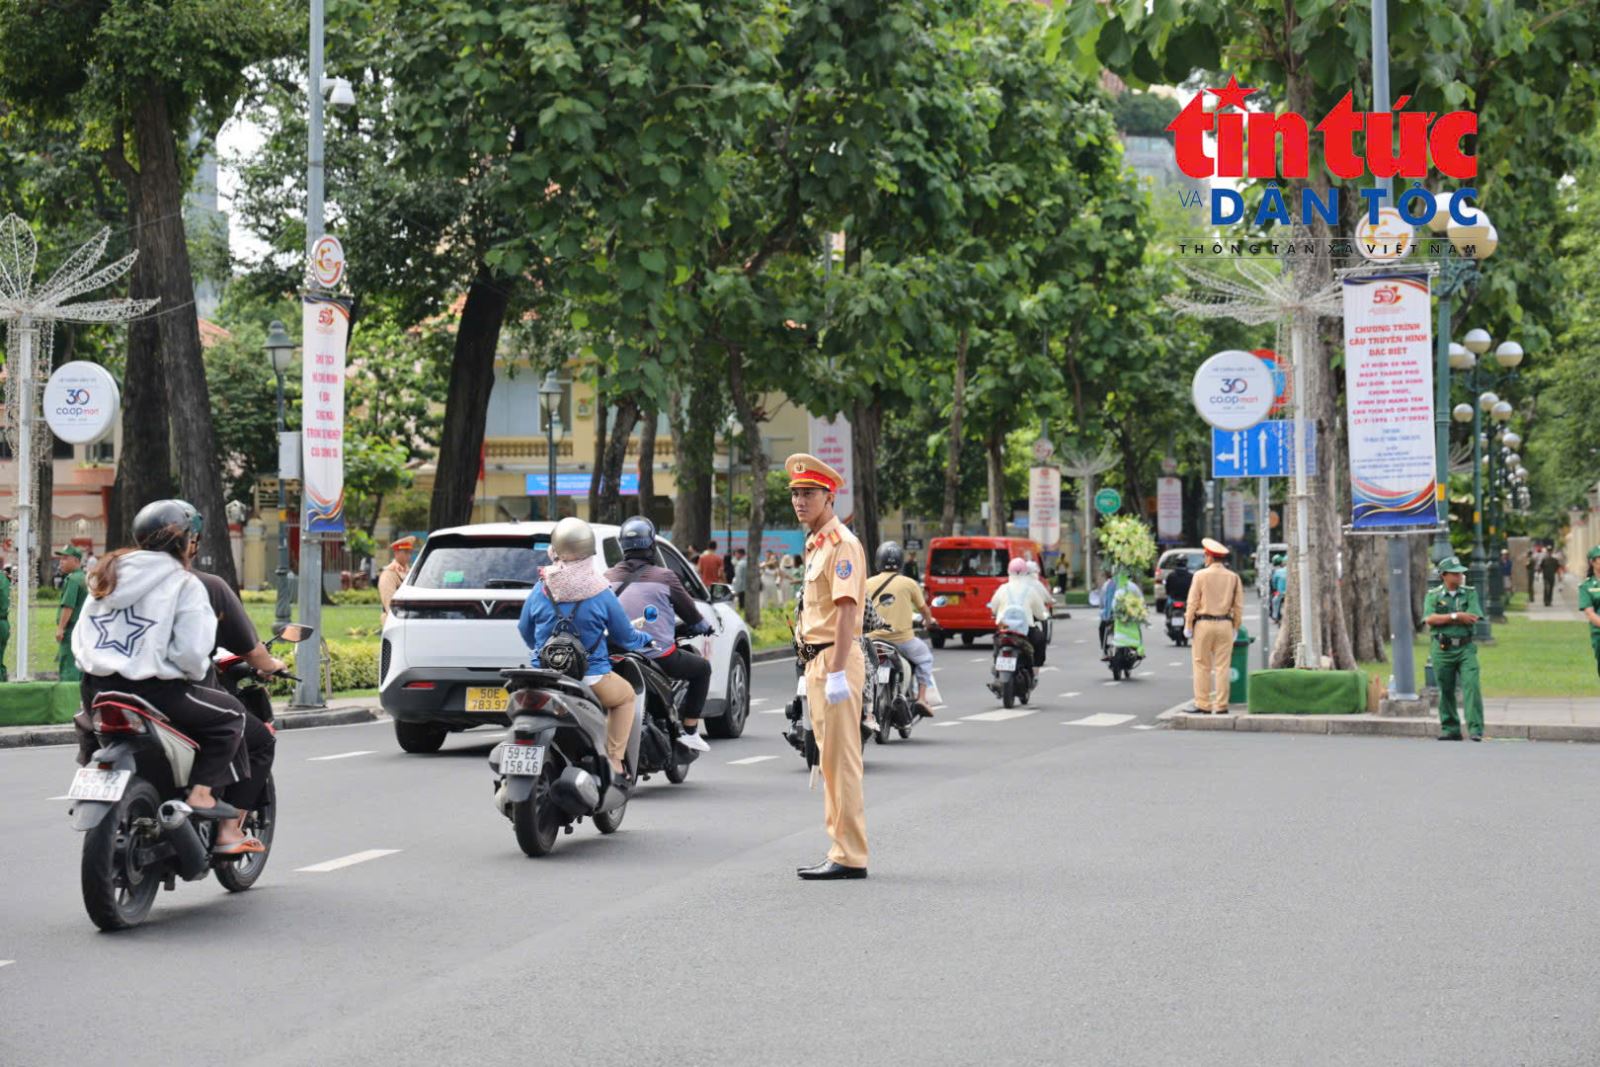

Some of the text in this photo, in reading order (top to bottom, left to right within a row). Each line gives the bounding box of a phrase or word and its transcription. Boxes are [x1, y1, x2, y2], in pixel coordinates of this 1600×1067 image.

[1220, 378, 1248, 394] 30
[66, 389, 90, 405] 30
[480, 688, 500, 699] 50E
